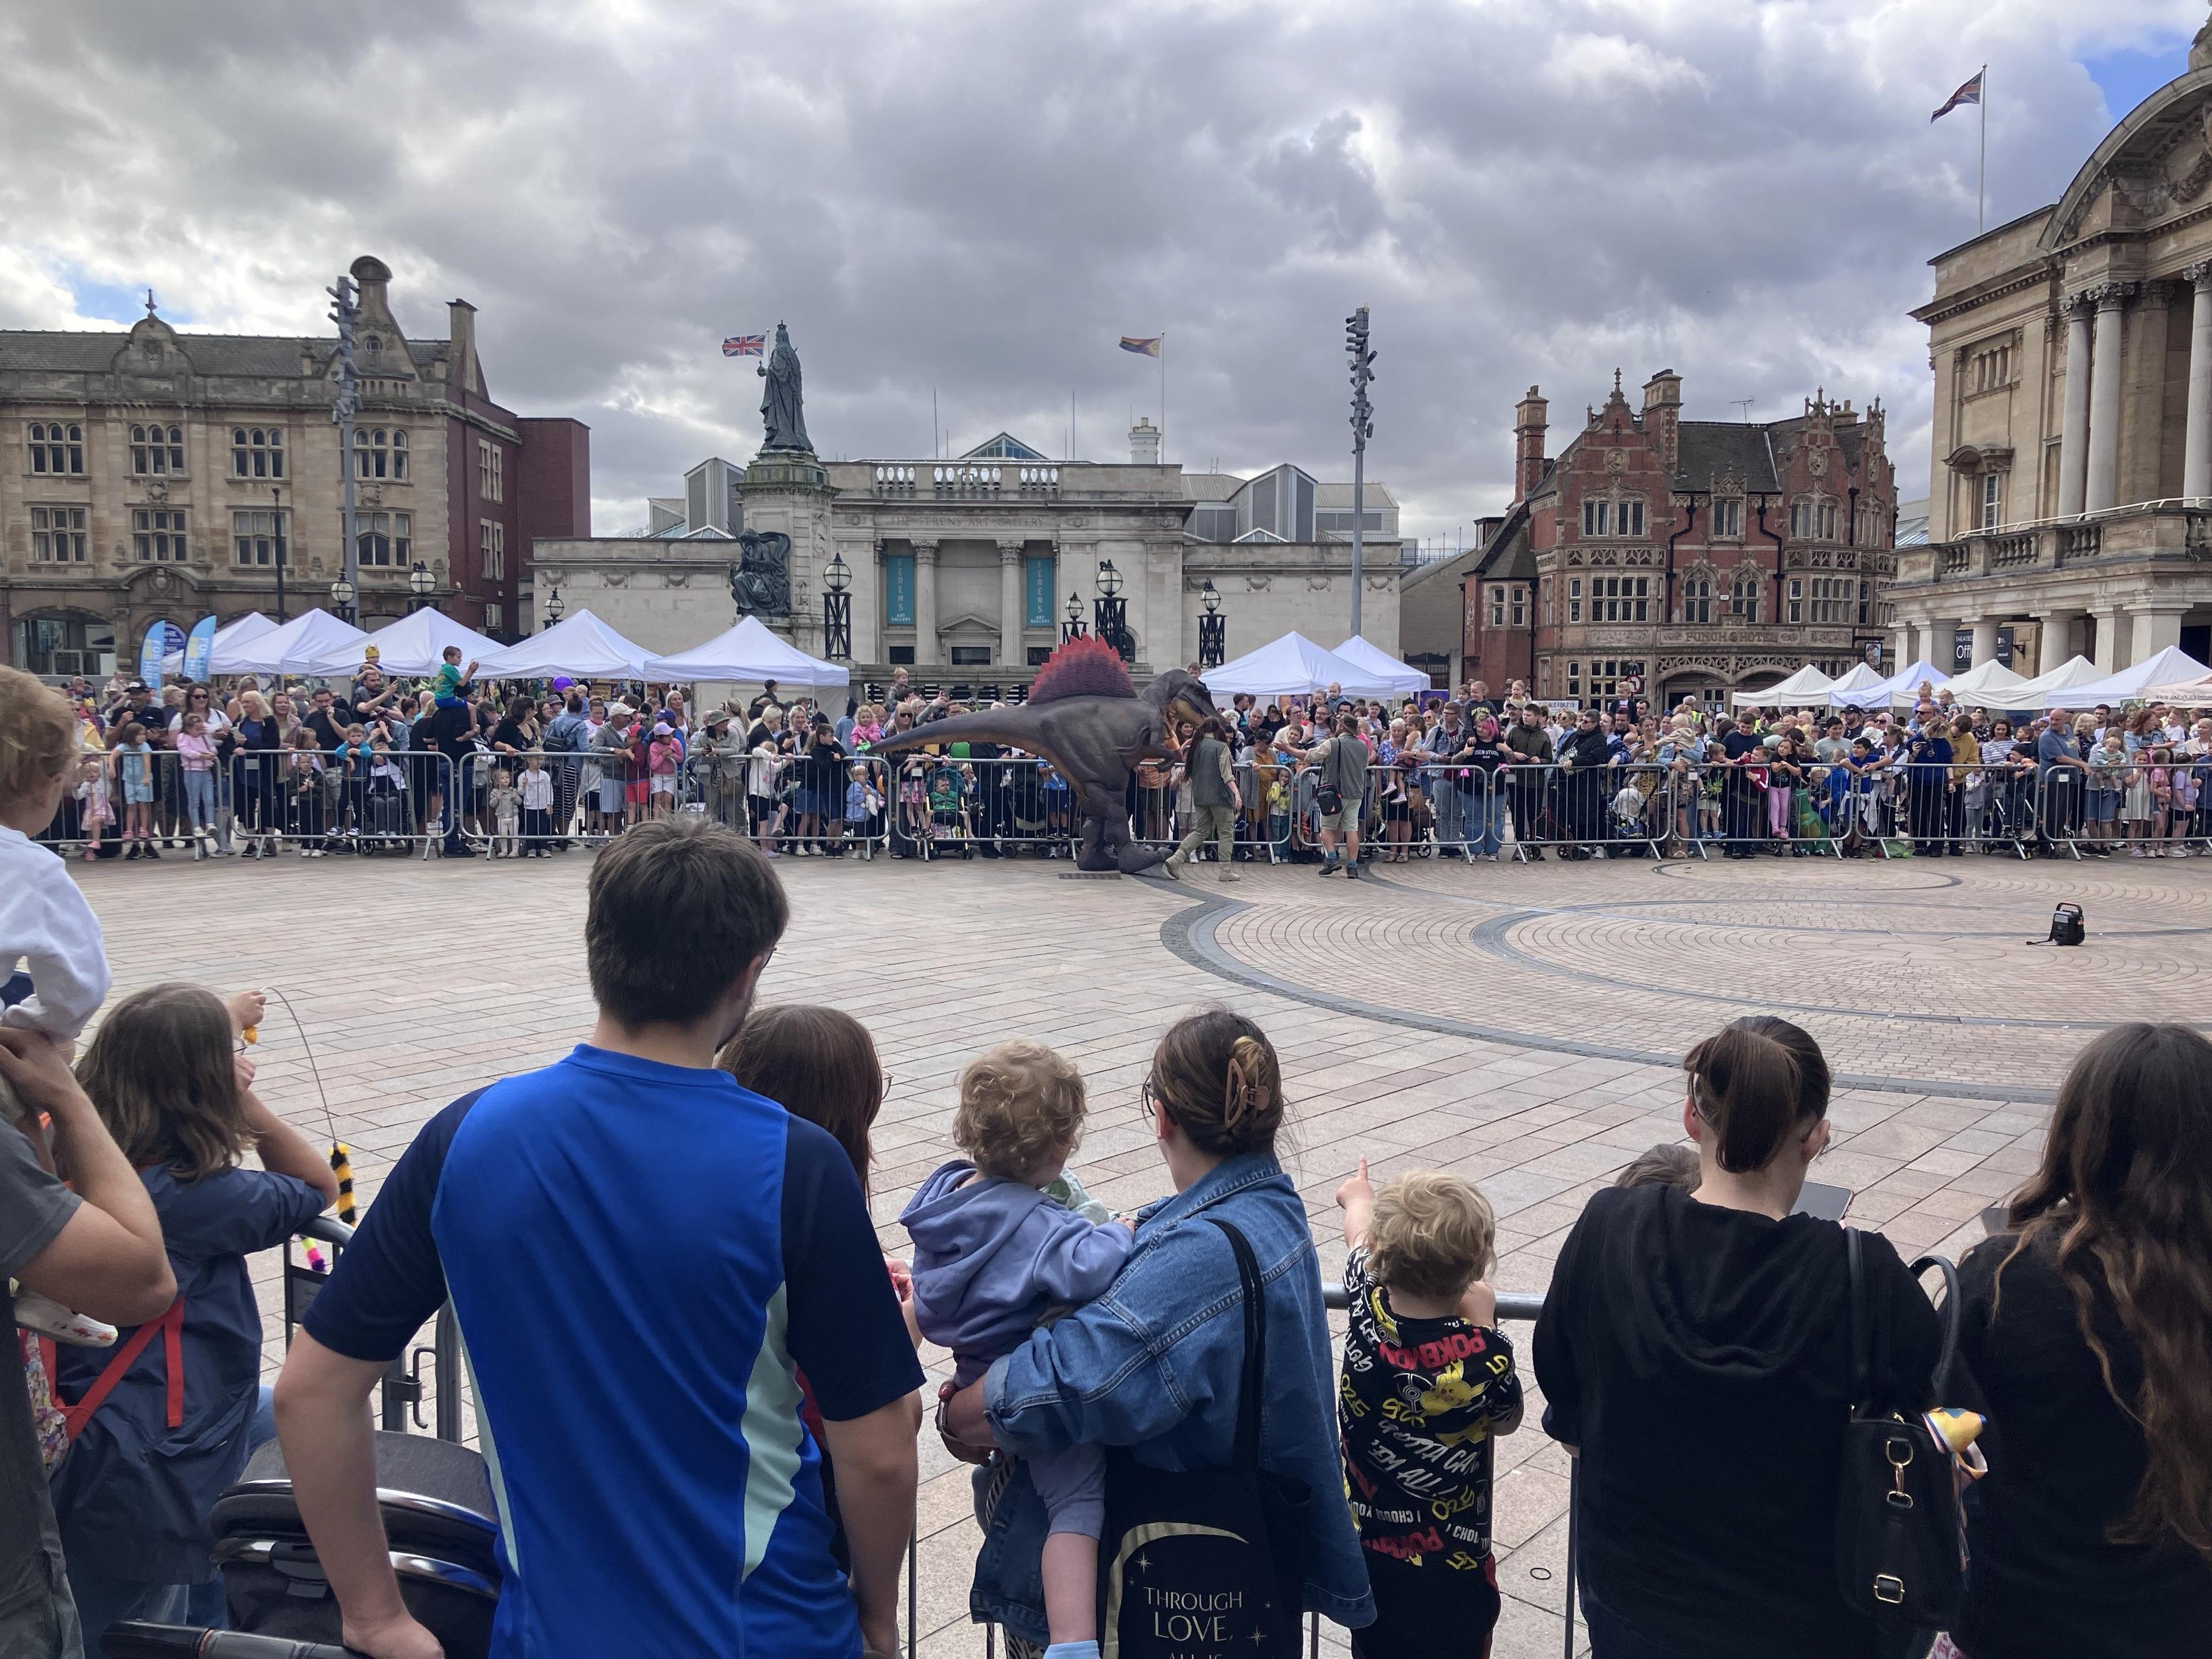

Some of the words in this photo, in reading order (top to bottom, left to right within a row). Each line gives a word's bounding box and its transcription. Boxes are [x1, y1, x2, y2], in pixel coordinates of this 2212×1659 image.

[1685, 631, 1727, 642] PUNCH
[1739, 631, 1778, 643] HOTEL
[1376, 1508, 1414, 1524] CHOOSE
[1417, 1510, 1421, 1523] I
[1143, 1586, 1242, 1611] THROUGH
[1155, 1611, 1233, 1642] LOVE,
